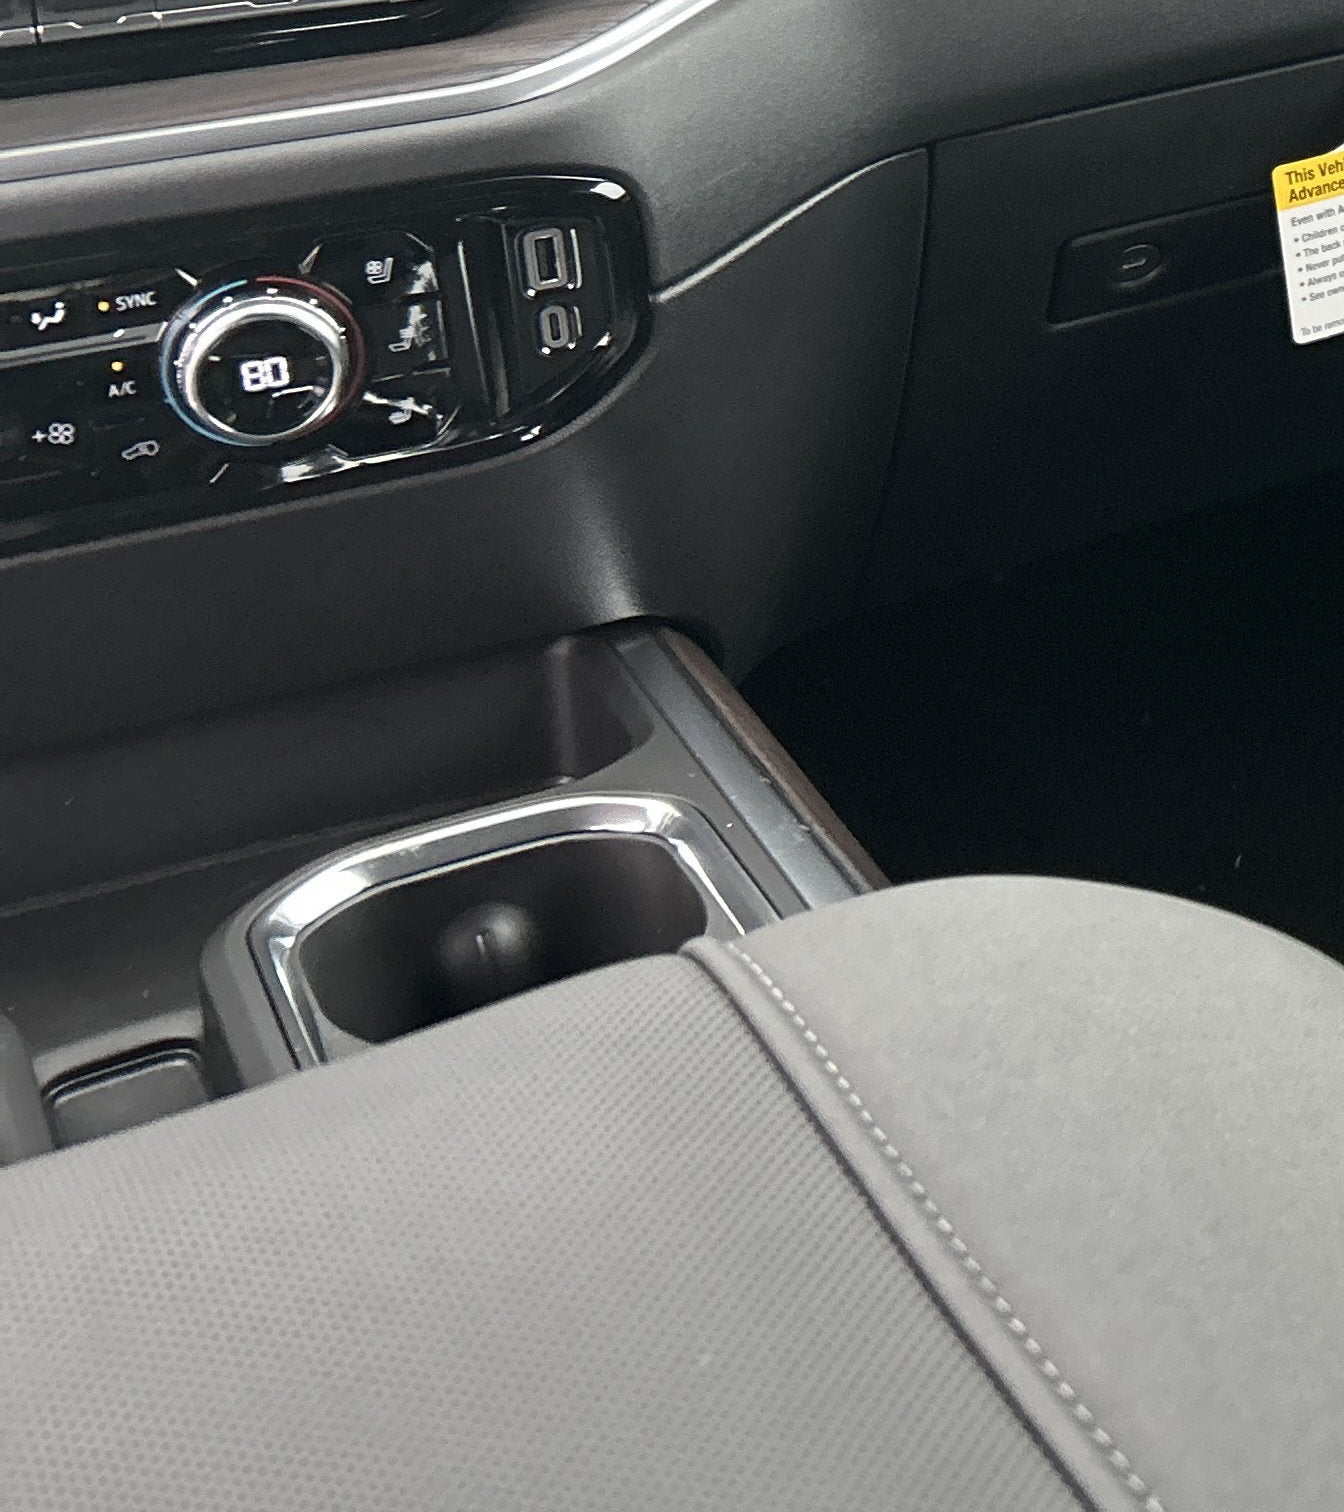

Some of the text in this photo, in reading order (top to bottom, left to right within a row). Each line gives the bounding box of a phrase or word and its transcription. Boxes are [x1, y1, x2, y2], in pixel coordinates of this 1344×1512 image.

[1284, 168, 1316, 185] This
[1290, 214, 1314, 227] Even
[1316, 207, 1336, 220] with
[1301, 226, 1338, 242] Children
[114, 291, 157, 312] SYNC
[239, 355, 291, 393] 80
[108, 380, 137, 398] A/C
